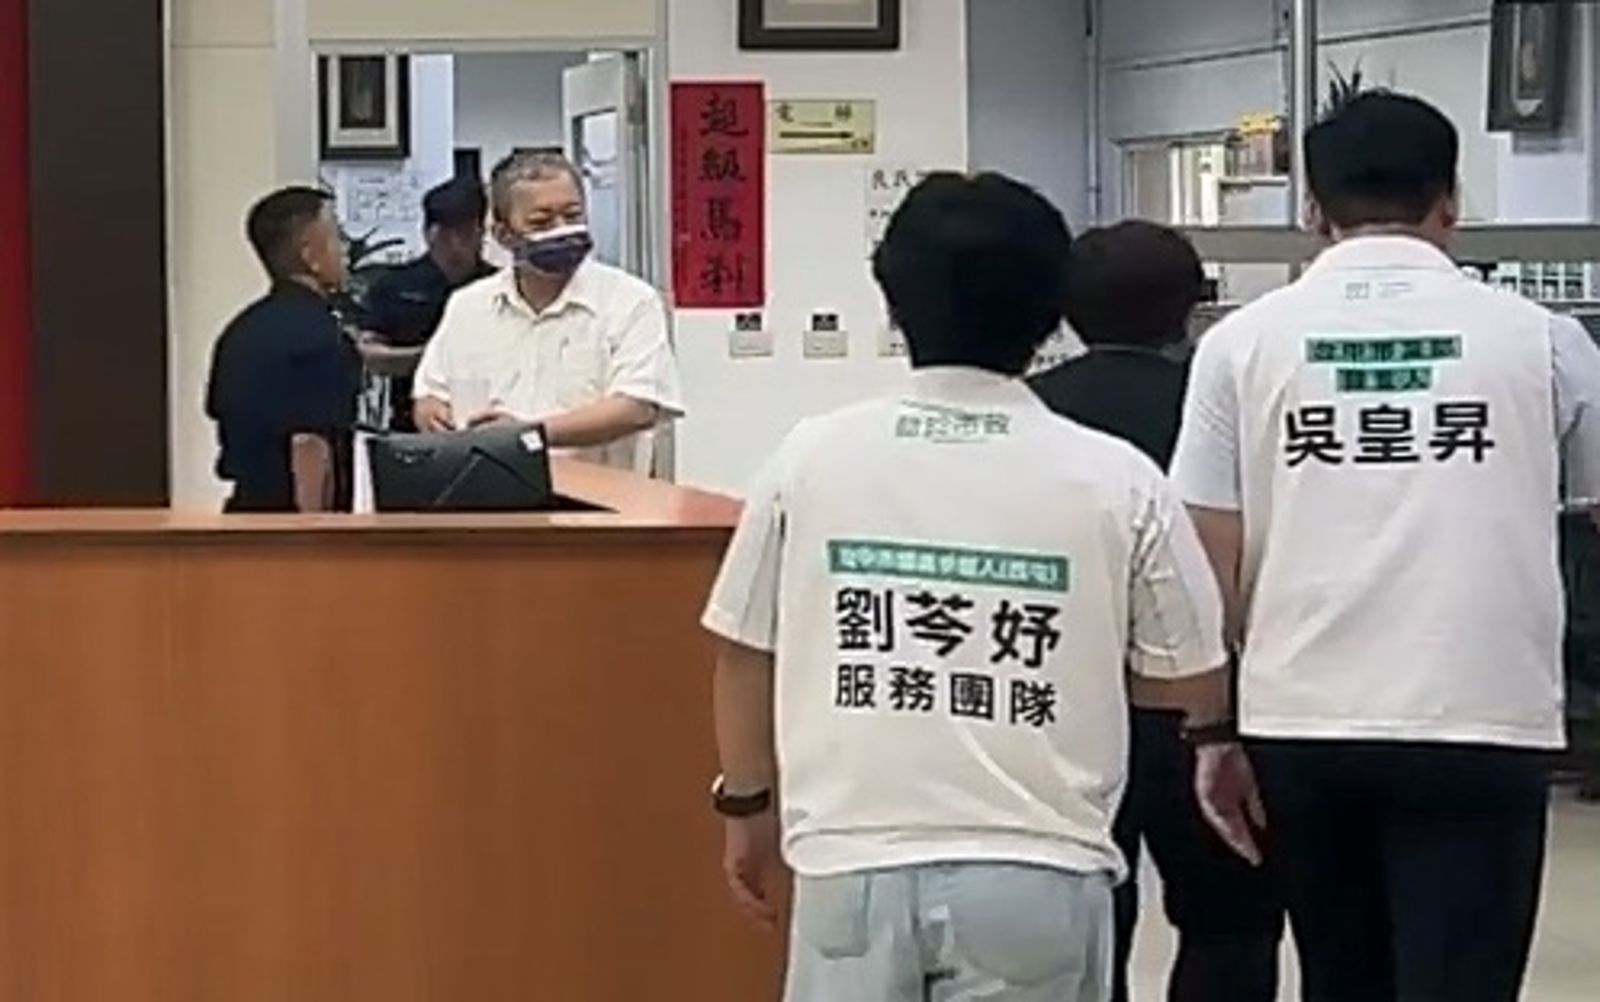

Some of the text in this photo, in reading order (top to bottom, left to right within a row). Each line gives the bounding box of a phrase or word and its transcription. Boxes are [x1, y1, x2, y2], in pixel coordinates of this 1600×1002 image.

[1284, 402, 1496, 467] 吳皇昇
[835, 588, 1062, 669] 劉芩妤
[835, 664, 1058, 726] 服務團隊
